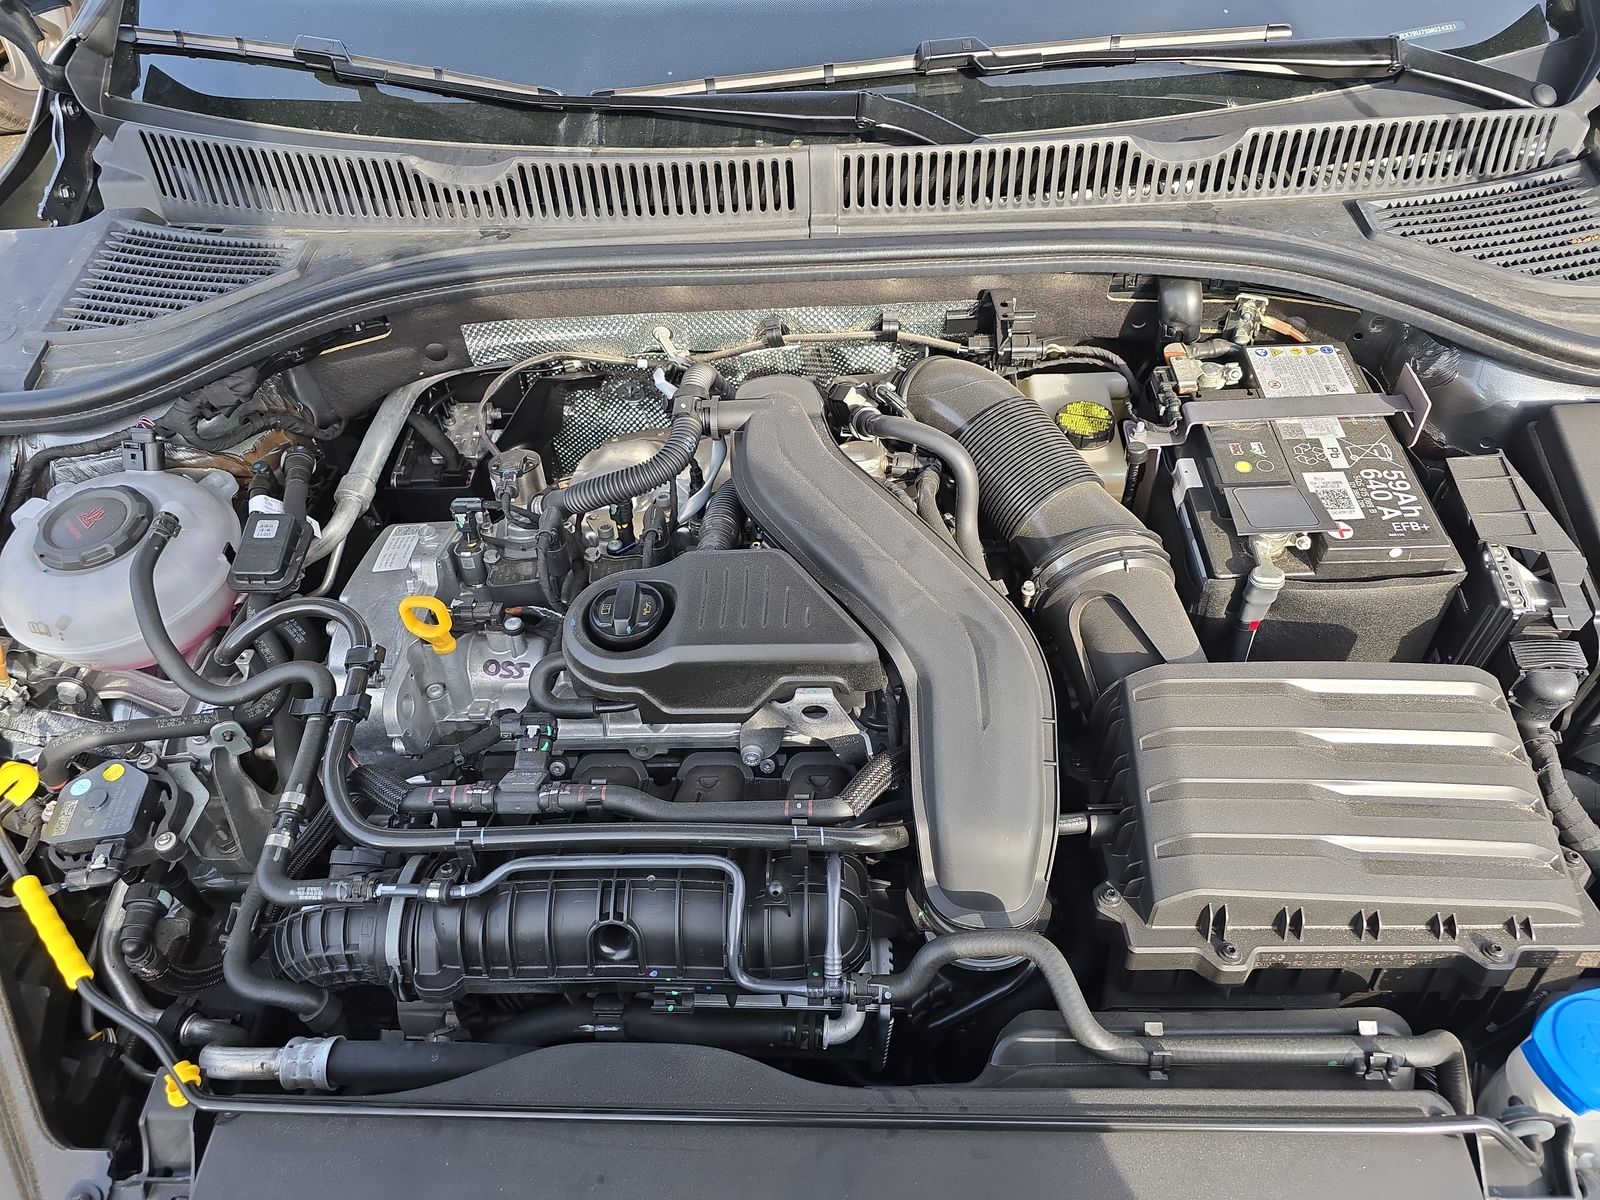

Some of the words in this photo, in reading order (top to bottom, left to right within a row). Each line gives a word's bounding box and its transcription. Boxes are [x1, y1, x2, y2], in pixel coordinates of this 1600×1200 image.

[1360, 469, 1393, 500] 640
[1382, 470, 1422, 517] 59Ah
[1376, 505, 1402, 520] A
[1391, 521, 1430, 531] EFB+
